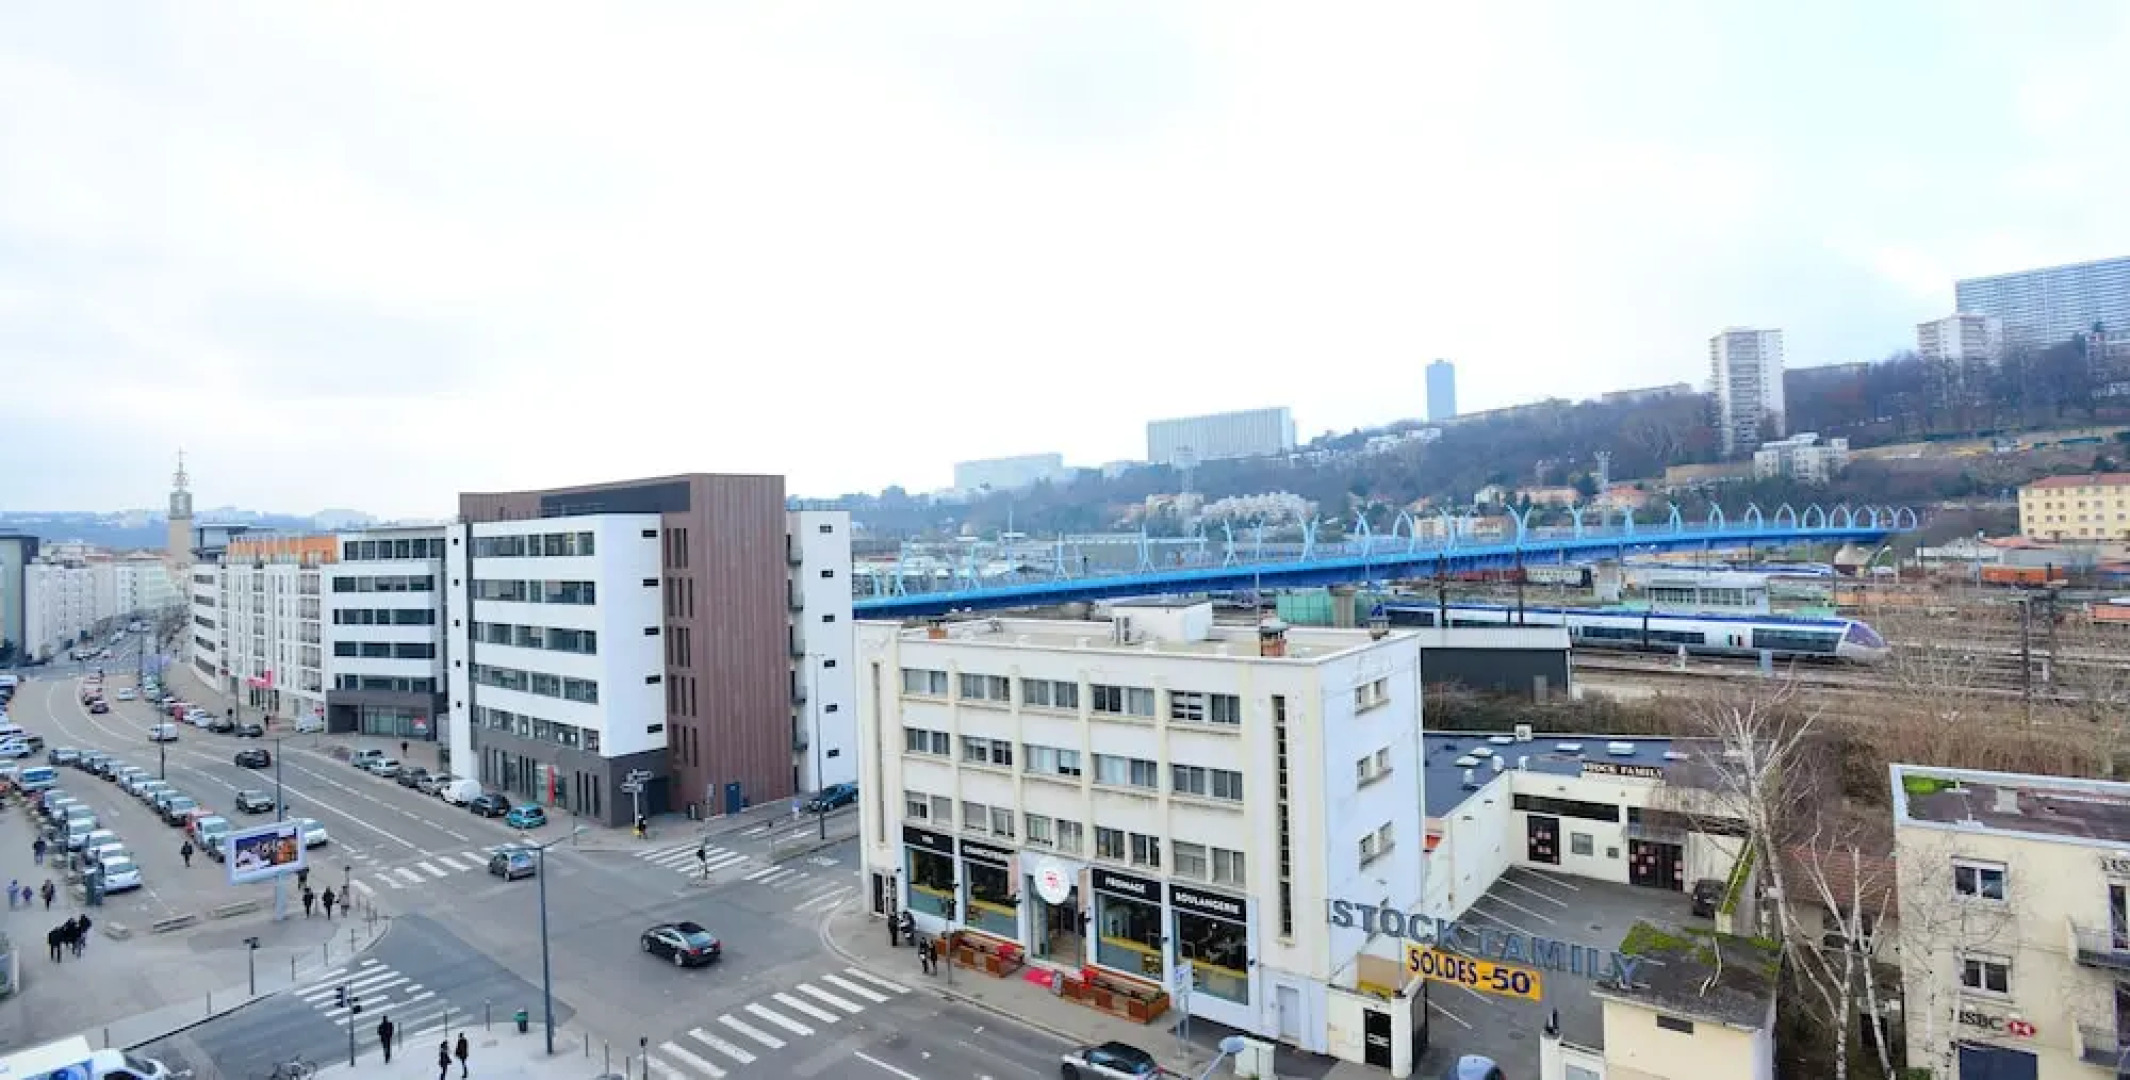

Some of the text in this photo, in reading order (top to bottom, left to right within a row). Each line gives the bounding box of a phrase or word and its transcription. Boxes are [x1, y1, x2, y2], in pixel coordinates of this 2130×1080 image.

[1333, 900, 1640, 988] STOCK FAMILY
[1410, 949, 1478, 984] SOLDES
